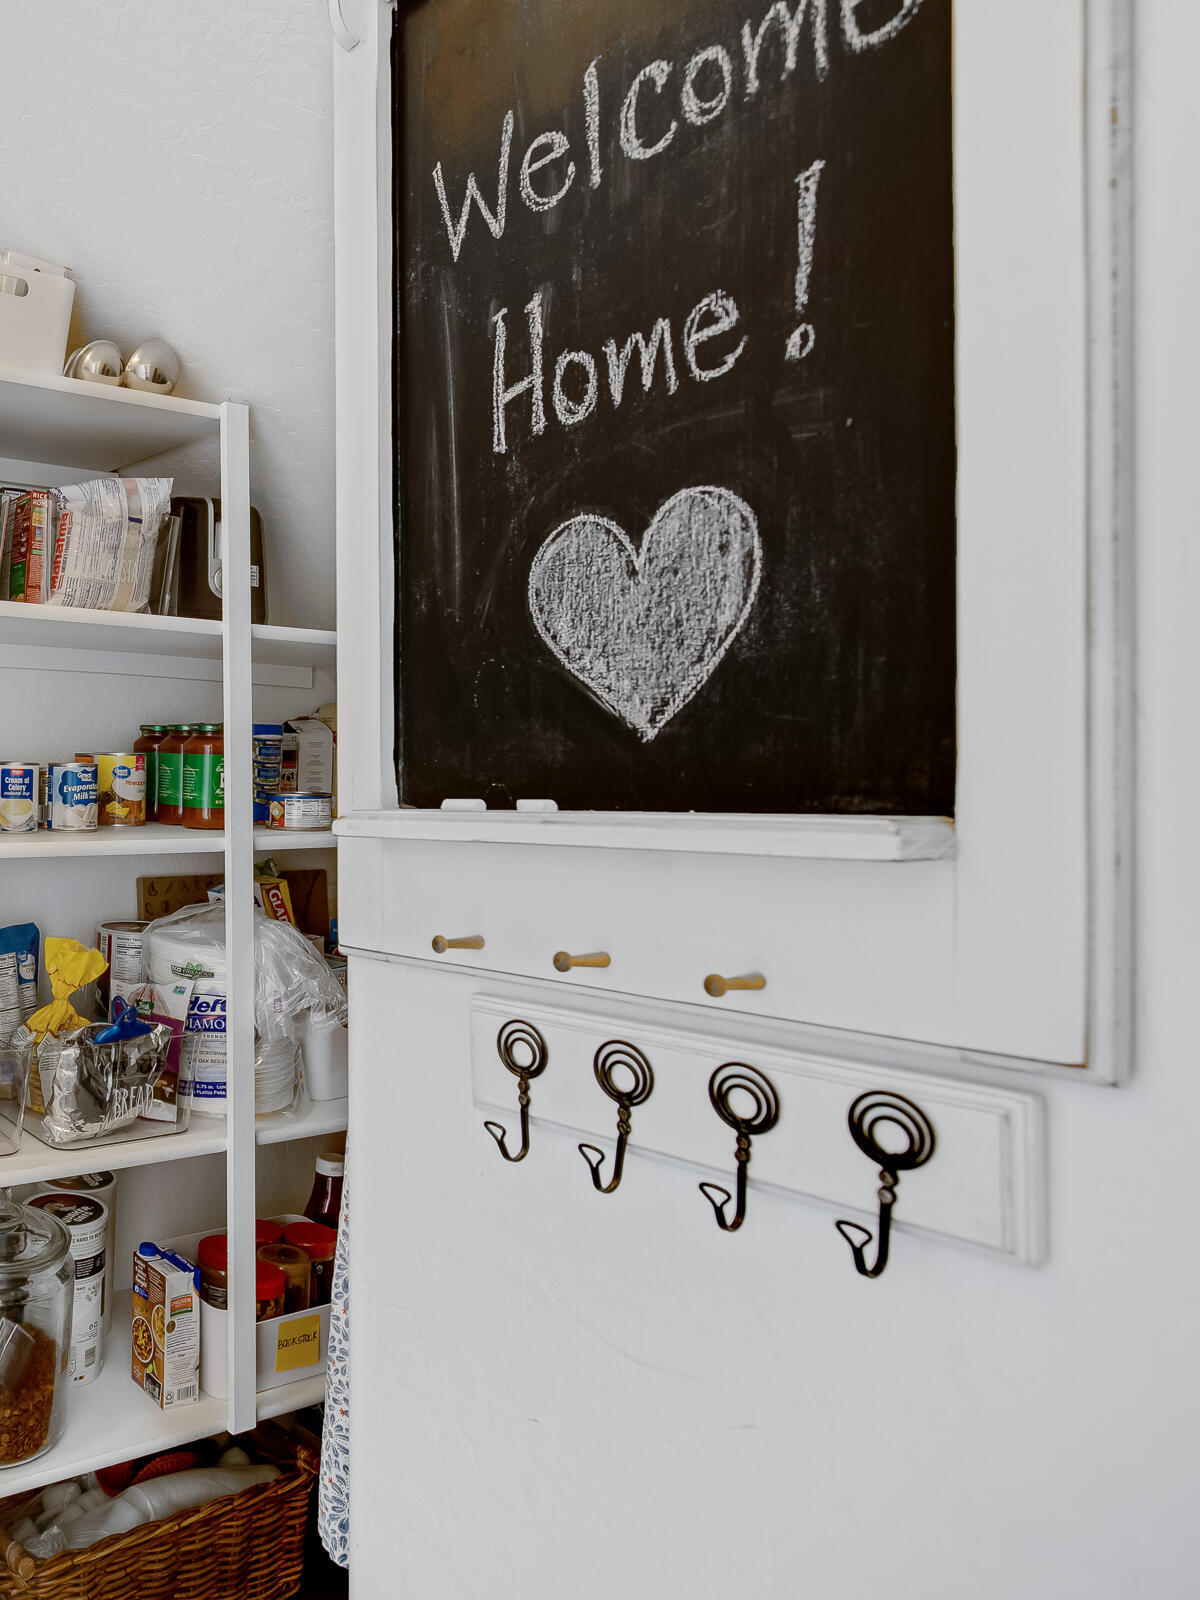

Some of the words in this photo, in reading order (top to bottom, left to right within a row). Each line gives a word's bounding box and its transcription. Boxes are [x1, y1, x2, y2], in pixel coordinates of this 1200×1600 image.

[432, 0, 925, 263] Welcome
[32, 492, 48, 500] RICE
[50, 512, 69, 590] Mahatma
[4, 776, 24, 784] Cream
[24, 776, 30, 784] of
[8, 783, 27, 792] Celery
[73, 792, 89, 801] Milk
[112, 1083, 155, 1118] BREAD
[170, 1297, 192, 1308] CHICKEN
[277, 1329, 319, 1350] BACKSTOCK
